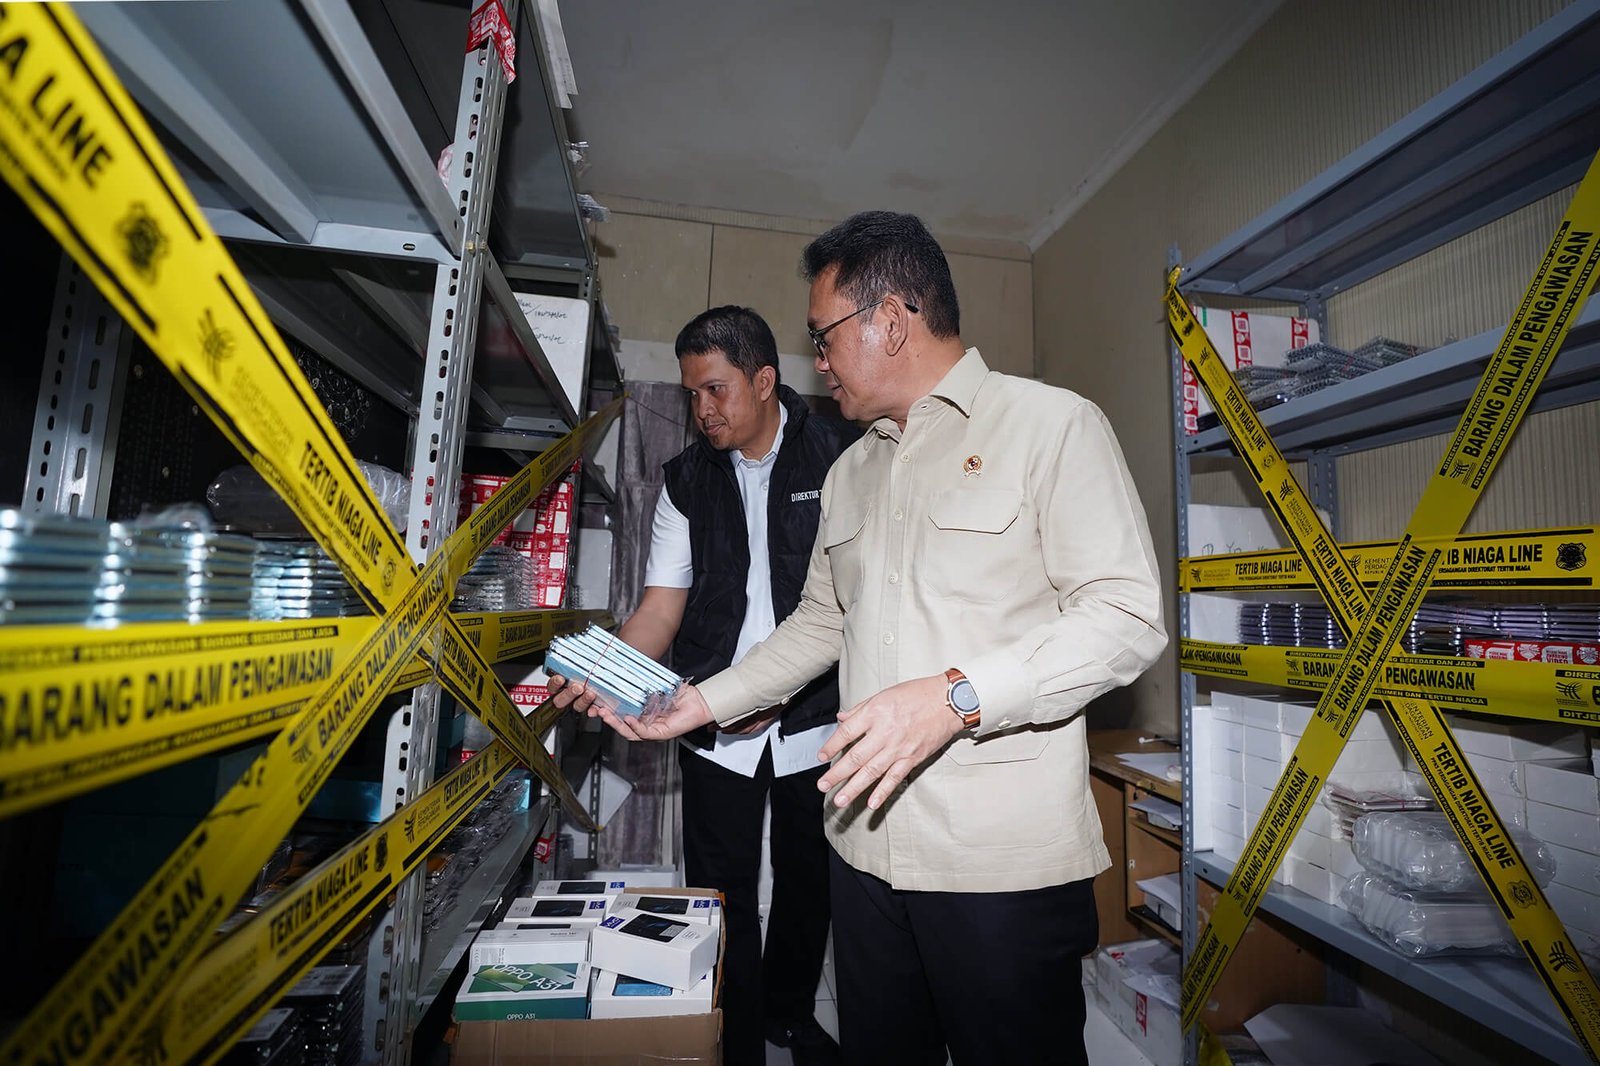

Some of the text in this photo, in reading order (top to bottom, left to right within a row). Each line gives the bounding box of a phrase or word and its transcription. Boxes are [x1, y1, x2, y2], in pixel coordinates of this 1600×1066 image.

[32, 76, 114, 189] LINE
[1441, 228, 1565, 470] DIREKTORAT PENGAWASAN BARANG BEREDAR DAN JASA
[1462, 231, 1593, 458] BARANG DALAM PENGAWASAN
[1472, 261, 1593, 487] DITJEN. PERLINDUNGAN KONSUMEN DAN TERTIB
[1225, 386, 1243, 413] TERTIB
[1239, 409, 1256, 436] NIAGA
[1251, 429, 1267, 451] LINE
[300, 441, 338, 506] TERTIB
[336, 491, 366, 541] NIAGA
[361, 529, 383, 565] LINE
[791, 490, 820, 502] DIREKTUR
[1235, 559, 1302, 575] TERTIB NIAGA LINE
[1312, 534, 1337, 572] TERTIB
[1331, 566, 1355, 600] NIAGA
[1464, 546, 1505, 565] NIAGA
[1509, 544, 1543, 563] LINE
[1334, 545, 1426, 711] BARANG DALAM PENGAWASAN
[1400, 604, 1411, 619] DAN
[143, 662, 223, 719] DALAM
[229, 647, 334, 703] PENGAWASAN
[316, 568, 445, 748] BARANG DALAM PENGAWASAN
[1195, 650, 1242, 665] PENGAWASAN
[1386, 667, 1475, 690] PENGAWASAN
[1374, 688, 1403, 696] SUMEN
[1423, 693, 1454, 701] TERTIB
[1404, 702, 1429, 739] DAGANGAN
[1410, 701, 1434, 737] ENTERIAN
[1239, 859, 1263, 893] BARANG
[1256, 827, 1278, 863] DALAM
[1271, 767, 1309, 831] PENGAWASAN
[1431, 742, 1516, 871] TERTIB NIAGA LINE
[269, 889, 314, 948] TERTIB
[315, 866, 348, 914] NIAGA
[349, 846, 370, 892] LINE
[493, 964, 561, 991] OPPO A31
